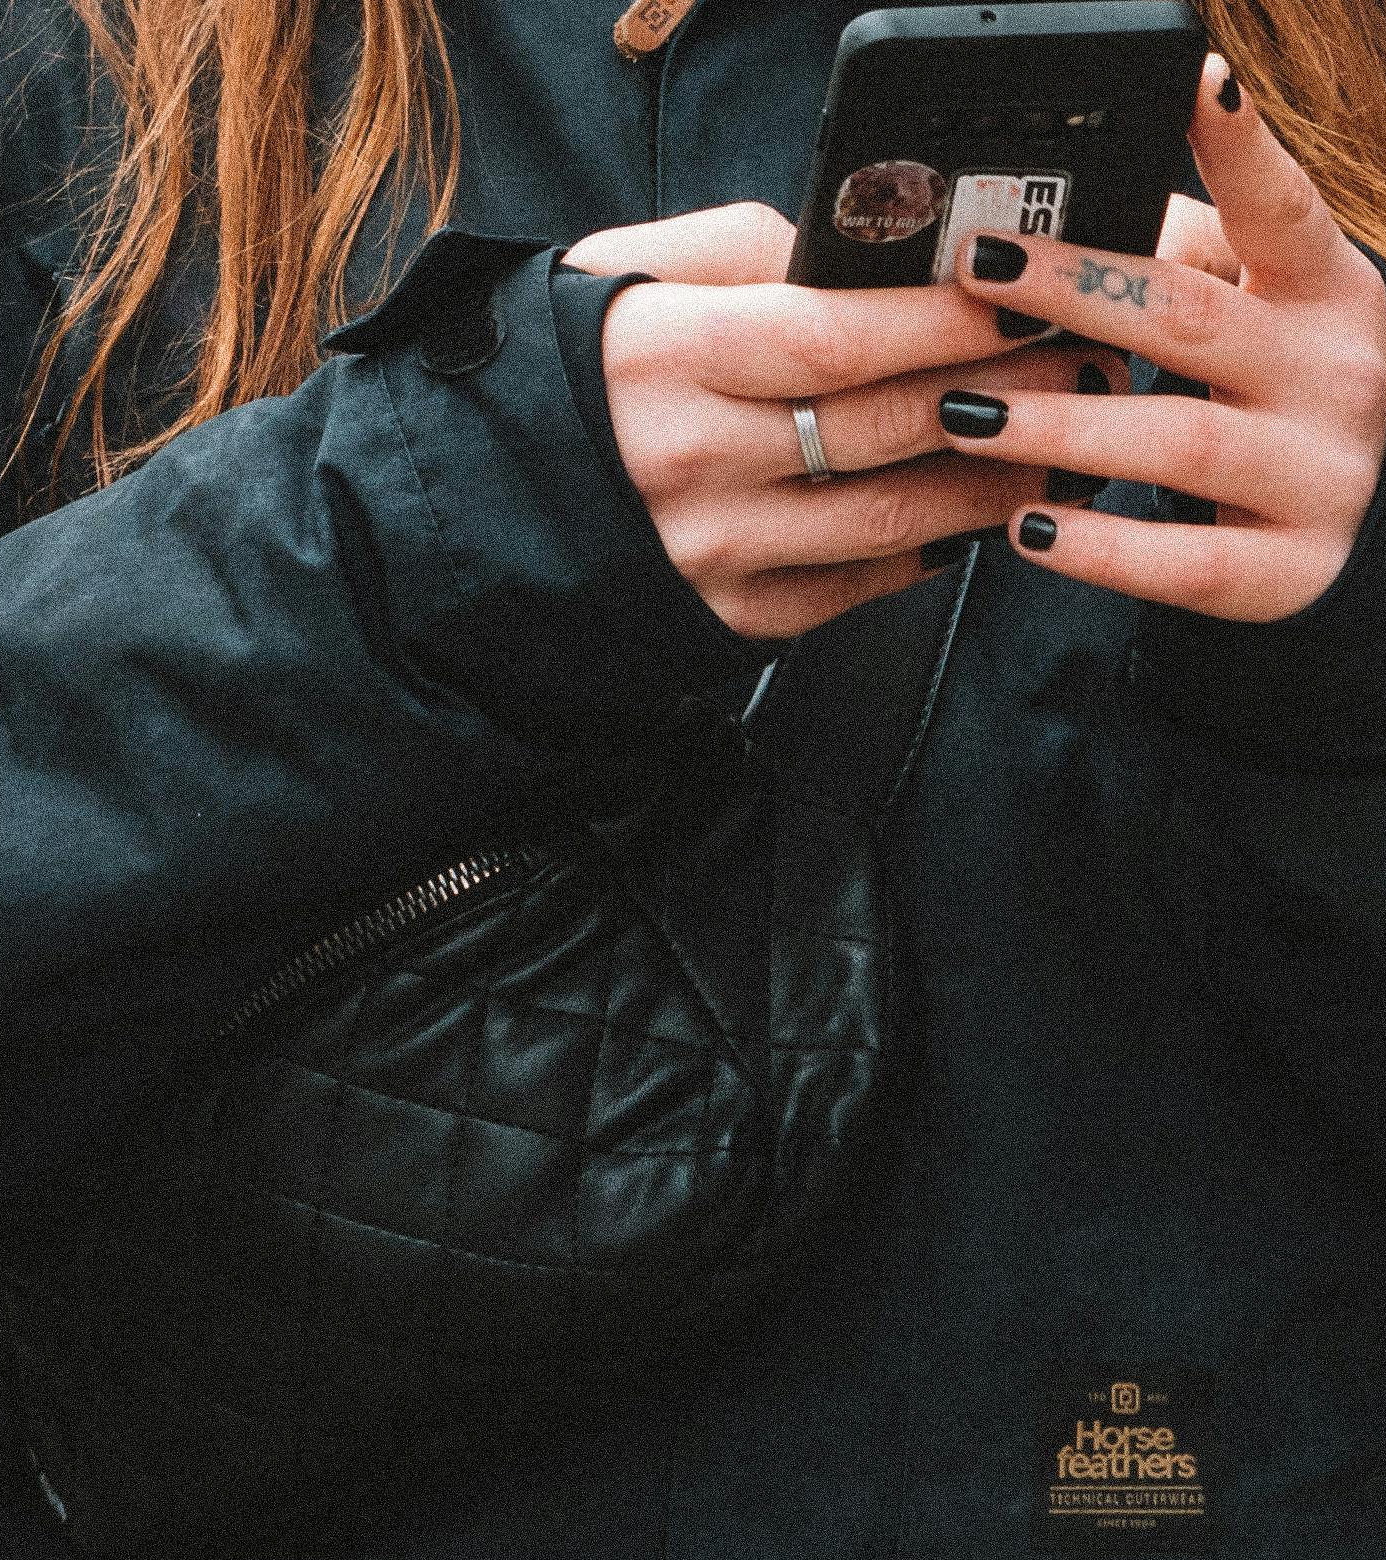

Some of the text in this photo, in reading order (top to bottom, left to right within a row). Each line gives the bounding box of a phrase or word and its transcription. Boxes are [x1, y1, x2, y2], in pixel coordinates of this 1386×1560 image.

[877, 216, 893, 228] TO
[1076, 1420, 1175, 1451] Horse
[1057, 1444, 1197, 1479] feathers
[1050, 1493, 1206, 1506] TECHNICAL OUTERWEAR
